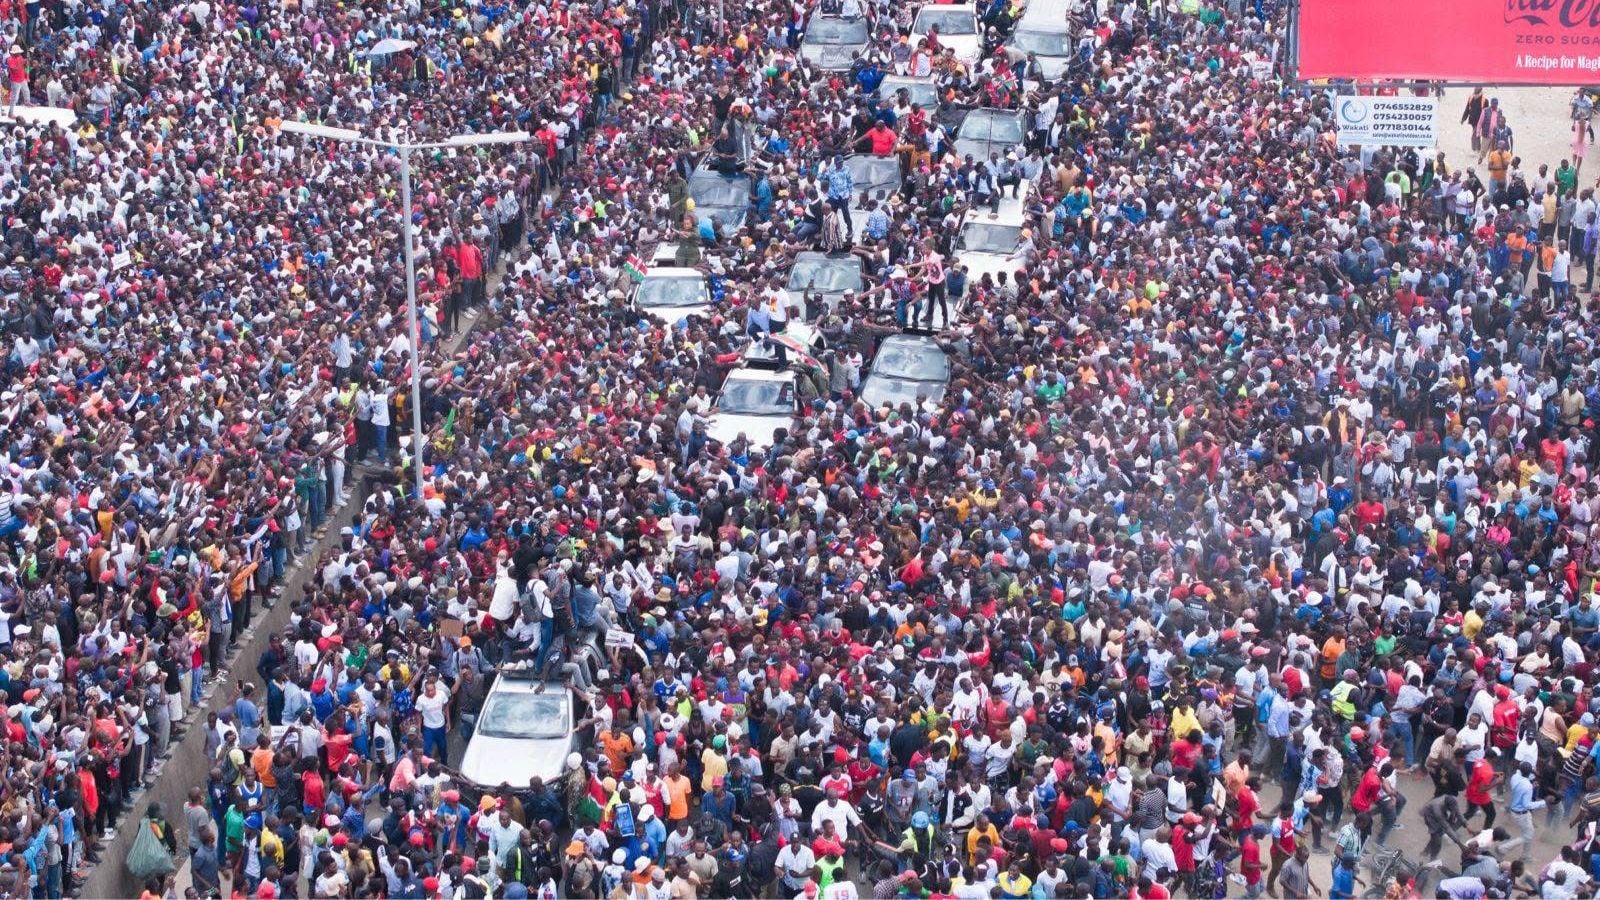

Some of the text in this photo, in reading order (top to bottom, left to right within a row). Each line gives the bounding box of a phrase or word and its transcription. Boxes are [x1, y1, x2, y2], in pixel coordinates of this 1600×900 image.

[1516, 35, 1600, 45] ZERO SUGA
[1516, 55, 1523, 68] A
[1525, 55, 1558, 70] Recipe
[1560, 55, 1575, 68] for
[1373, 103, 1433, 111] 0746552829
[1373, 113, 1433, 121] 0754230057
[1373, 123, 1431, 131] 0771830144
